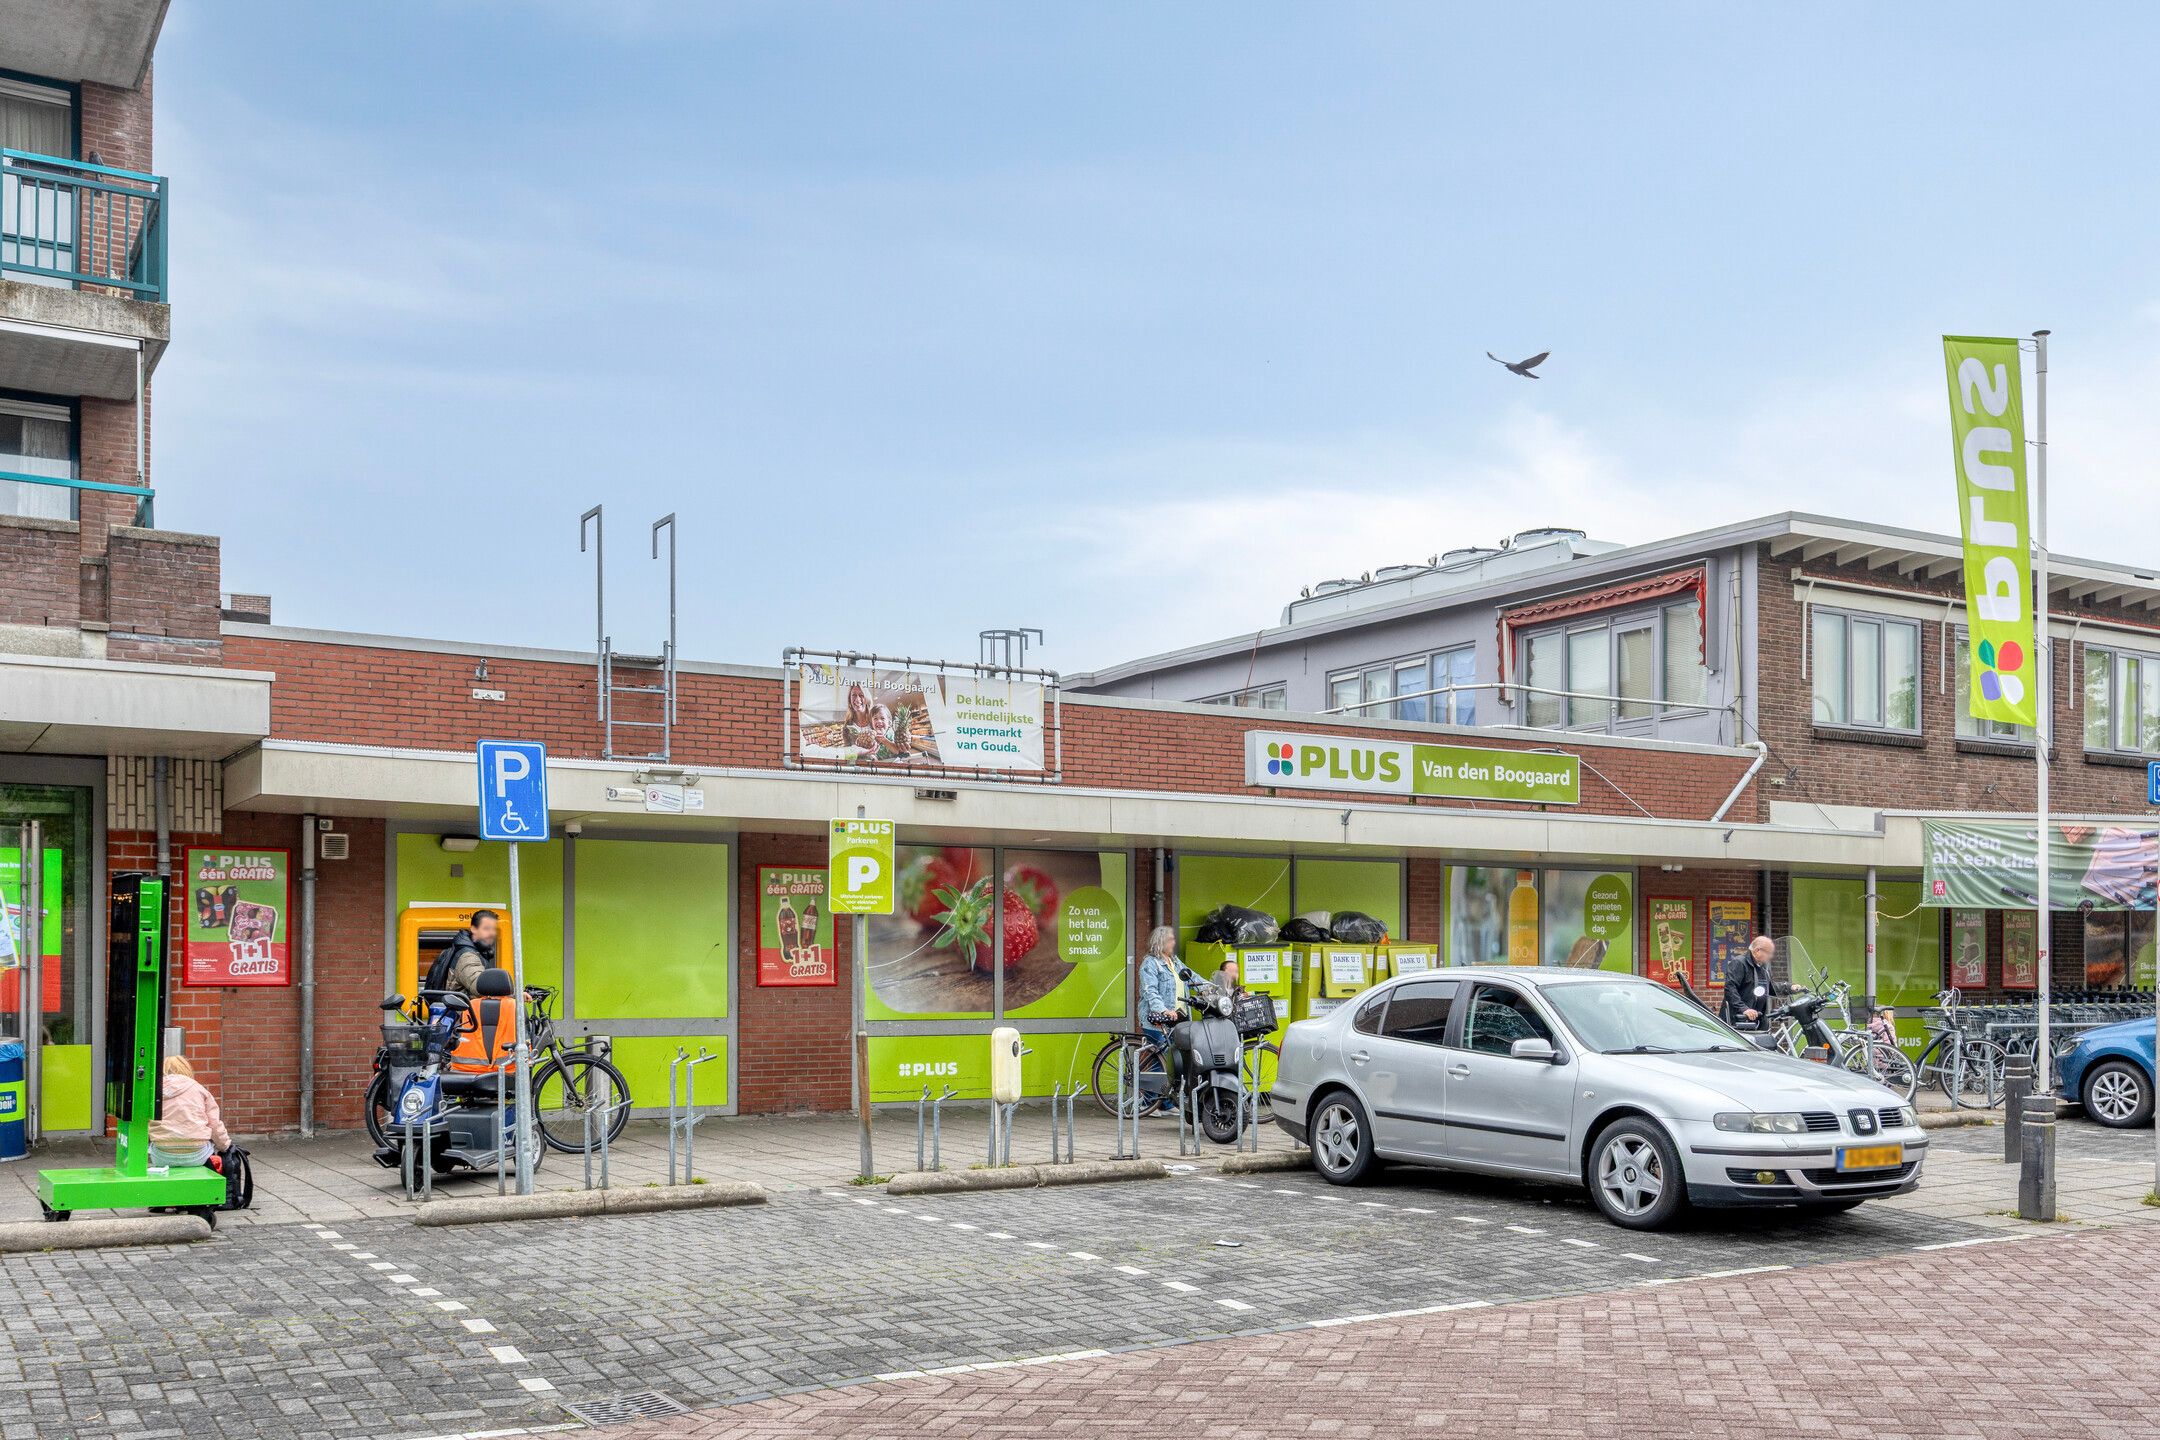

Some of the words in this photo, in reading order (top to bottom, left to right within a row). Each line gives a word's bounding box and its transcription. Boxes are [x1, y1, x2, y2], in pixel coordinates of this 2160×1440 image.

[808, 674, 835, 685] PLUS
[838, 677, 857, 687] Van
[860, 678, 880, 689] den
[884, 680, 936, 693] Boogaard
[956, 694, 972, 704] De
[975, 695, 1008, 707] klant-
[956, 710, 1034, 725] vriendelijkste
[956, 726, 1022, 738] supermarkt
[957, 741, 977, 750] van
[981, 741, 1020, 753] Gouda.
[1300, 742, 1401, 783] PLUS
[495, 750, 531, 798] P
[1422, 760, 1453, 779] Van
[1458, 762, 1489, 781] den
[1494, 765, 1570, 788] Boogaard
[847, 822, 891, 835] PLUS
[847, 836, 879, 845] Parkeren
[220, 855, 272, 868] PLUS
[1932, 848, 1958, 864] als
[1963, 853, 1997, 866] een
[199, 867, 226, 880] één
[230, 867, 275, 880] GRATIS
[783, 873, 822, 884] PLUS
[848, 856, 880, 892] P
[767, 884, 787, 894] één
[790, 884, 824, 894] GRATIS
[1592, 890, 1618, 900] Gezond
[1068, 906, 1081, 916] Zo
[1083, 908, 1100, 916] van
[1592, 903, 1622, 912] genieten
[1663, 904, 1687, 912] PLUS
[1606, 913, 1620, 922] elke
[1068, 918, 1085, 929] het
[1087, 918, 1110, 930] land,
[1592, 924, 1607, 935] dag.
[1068, 932, 1083, 941] vol
[231, 938, 271, 961] 1+1
[791, 945, 821, 963] 1+1
[1068, 945, 1101, 955] smaak.
[230, 960, 278, 974] GRATIS
[790, 964, 826, 976] GRATIS
[1898, 1037, 1922, 1047] PLUS
[913, 1062, 958, 1076] PLUS
